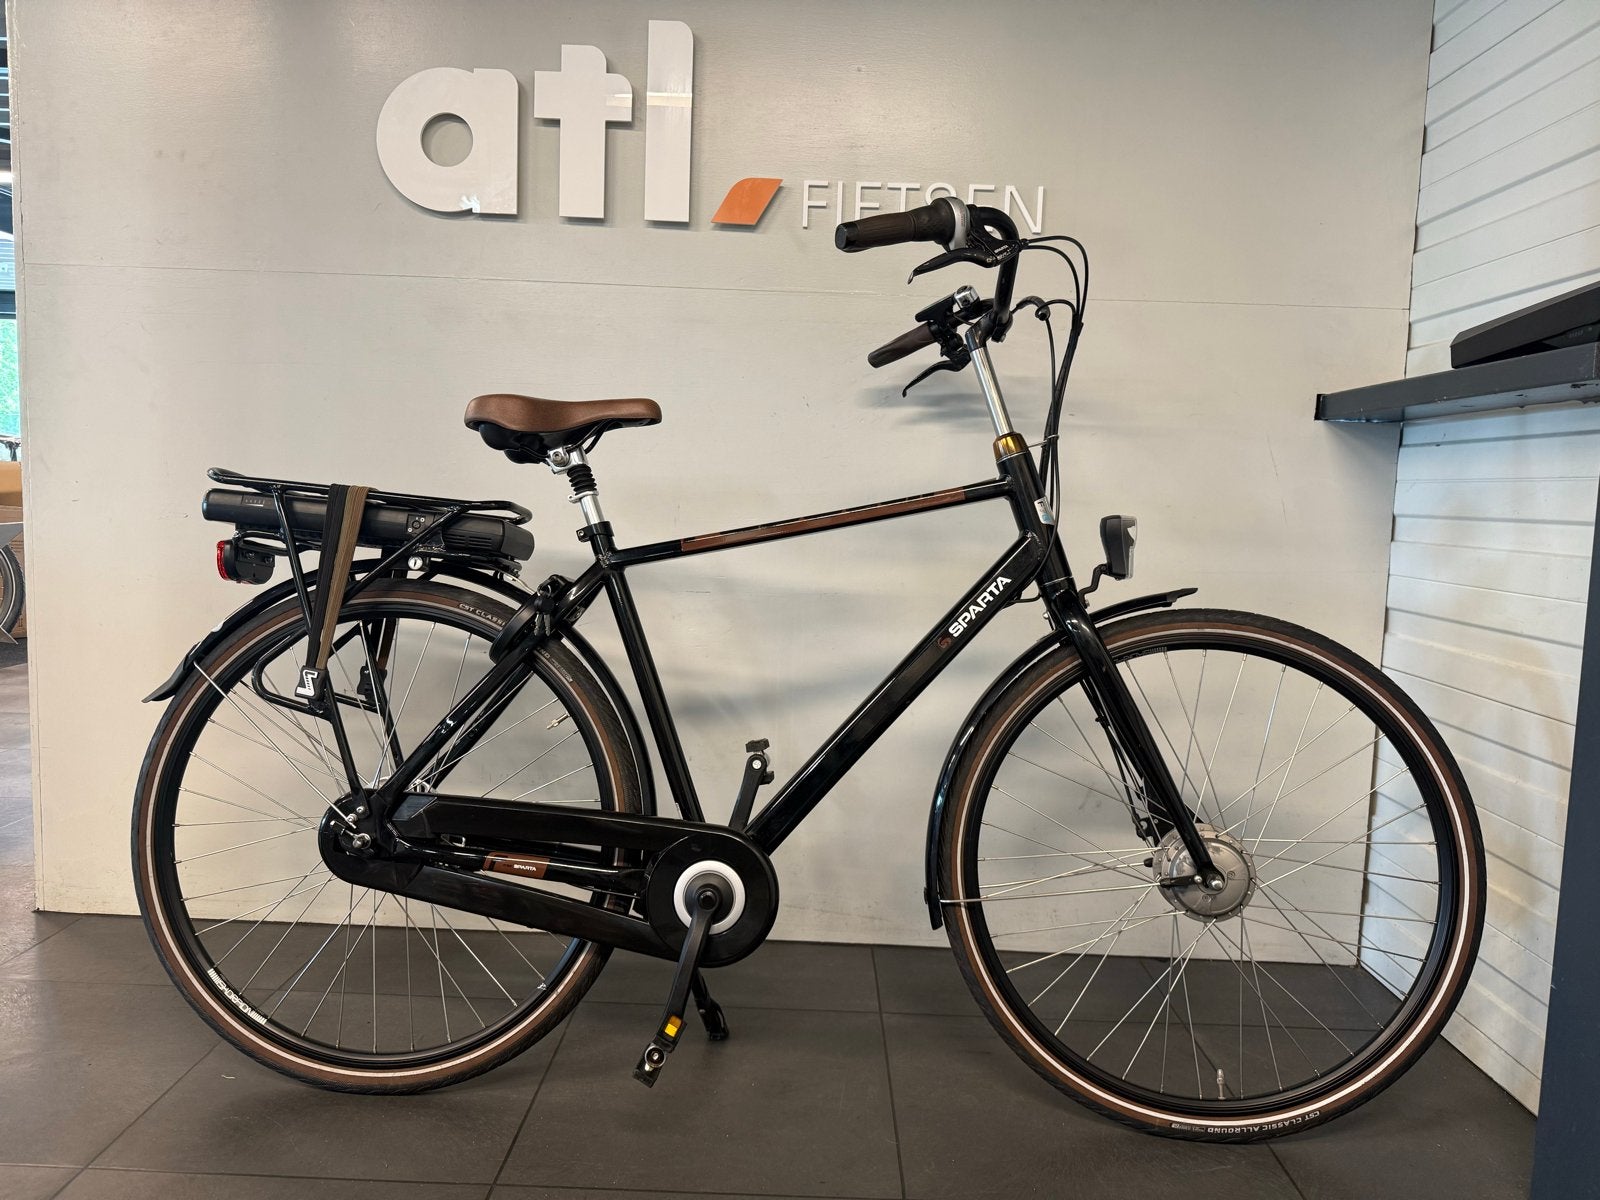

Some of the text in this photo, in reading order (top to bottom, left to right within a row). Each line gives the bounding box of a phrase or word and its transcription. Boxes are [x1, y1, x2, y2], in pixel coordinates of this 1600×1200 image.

[376, 20, 694, 222] atl
[948, 576, 1012, 637] SPARTA
[460, 603, 506, 627] CST CLASSI
[513, 863, 537, 872] SPARTA
[1304, 1111, 1320, 1120] CST
[1207, 1126, 1260, 1135] ALLROUND
[1262, 1118, 1302, 1131] CLASSIC
